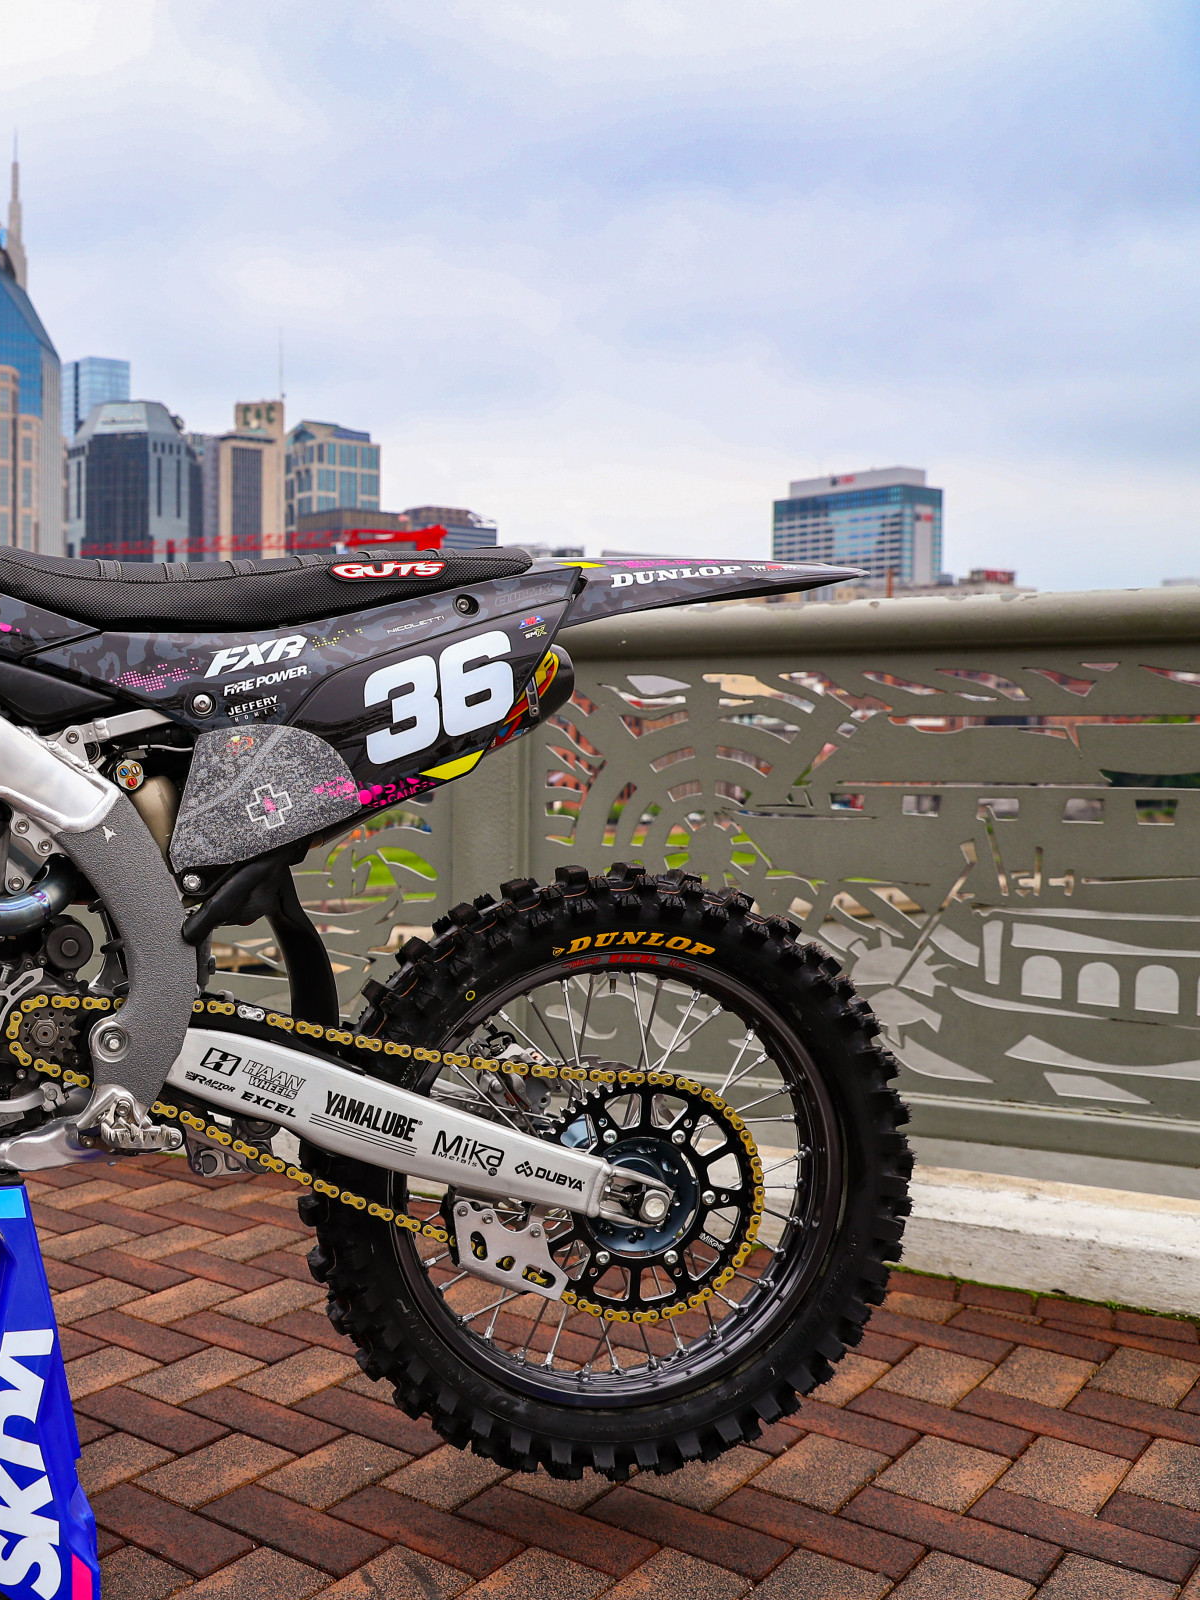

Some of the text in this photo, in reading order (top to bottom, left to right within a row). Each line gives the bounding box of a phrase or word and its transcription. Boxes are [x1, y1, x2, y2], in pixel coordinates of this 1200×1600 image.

[331, 560, 445, 578] GUTS
[610, 565, 742, 588] DUNLOP
[495, 583, 553, 606] CLUBMX
[386, 615, 445, 634] NICOLETTI
[204, 634, 307, 679] FXR
[224, 665, 308, 697] FIRE POWER
[228, 695, 278, 716] JEFFERY
[364, 630, 514, 765] 36
[234, 707, 277, 723] HOMES
[566, 931, 716, 955] DUNLOP
[608, 953, 659, 964] EXCEL
[194, 1073, 235, 1092] RAPTOR
[242, 1060, 306, 1091] HAAN
[248, 1076, 299, 1100] WHEELS
[240, 1091, 296, 1118] EXCEL
[324, 1090, 419, 1142] YAMALUBE
[432, 1130, 505, 1171] Mika
[437, 1151, 478, 1167] Metals
[534, 1167, 583, 1192] DUBYA
